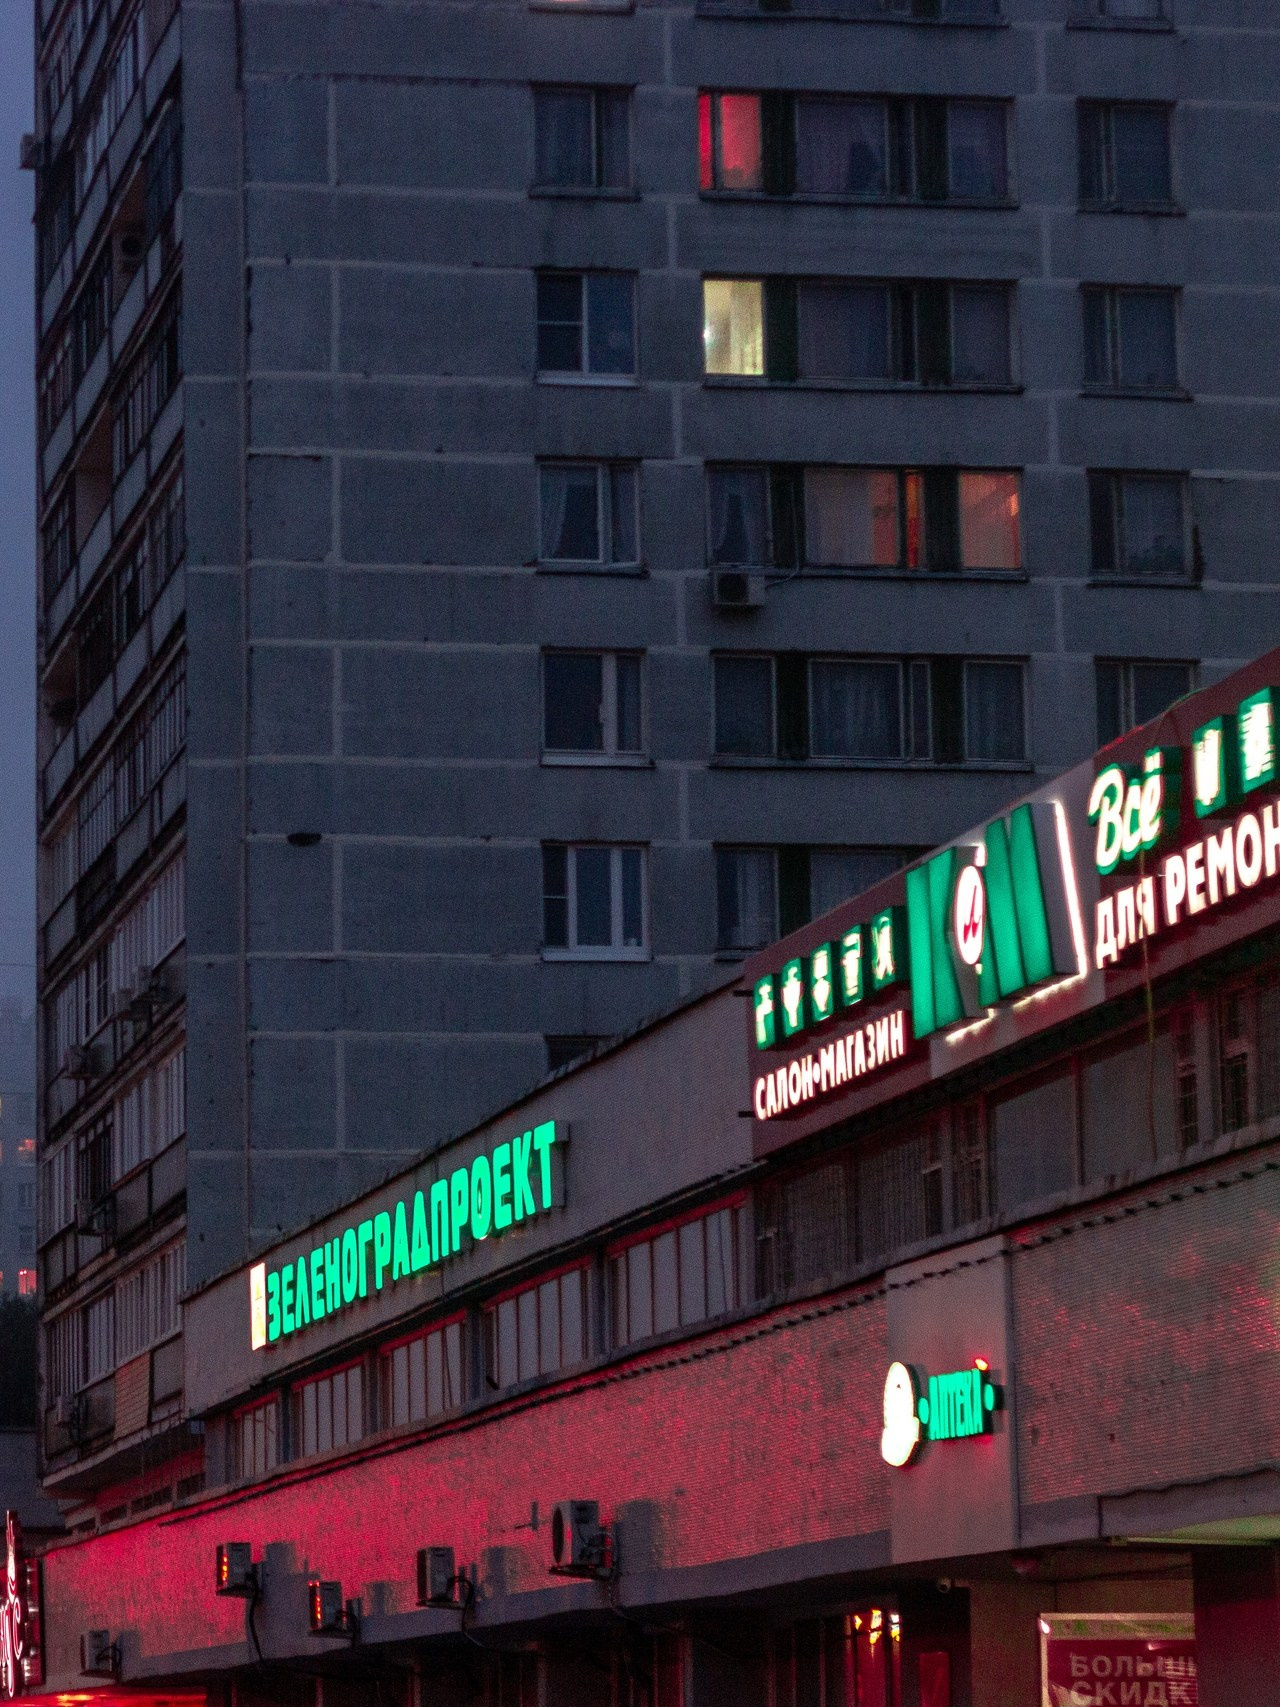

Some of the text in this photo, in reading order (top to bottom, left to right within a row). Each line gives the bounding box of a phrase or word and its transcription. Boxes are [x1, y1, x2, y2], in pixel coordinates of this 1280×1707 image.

[1088, 746, 1166, 876] Всё
[1096, 876, 1157, 970] ДЛЯ
[267, 1120, 556, 1342] ЗЕЛЕНОГРАДПРОЕКТ
[928, 1368, 984, 1441] АПТЕКА
